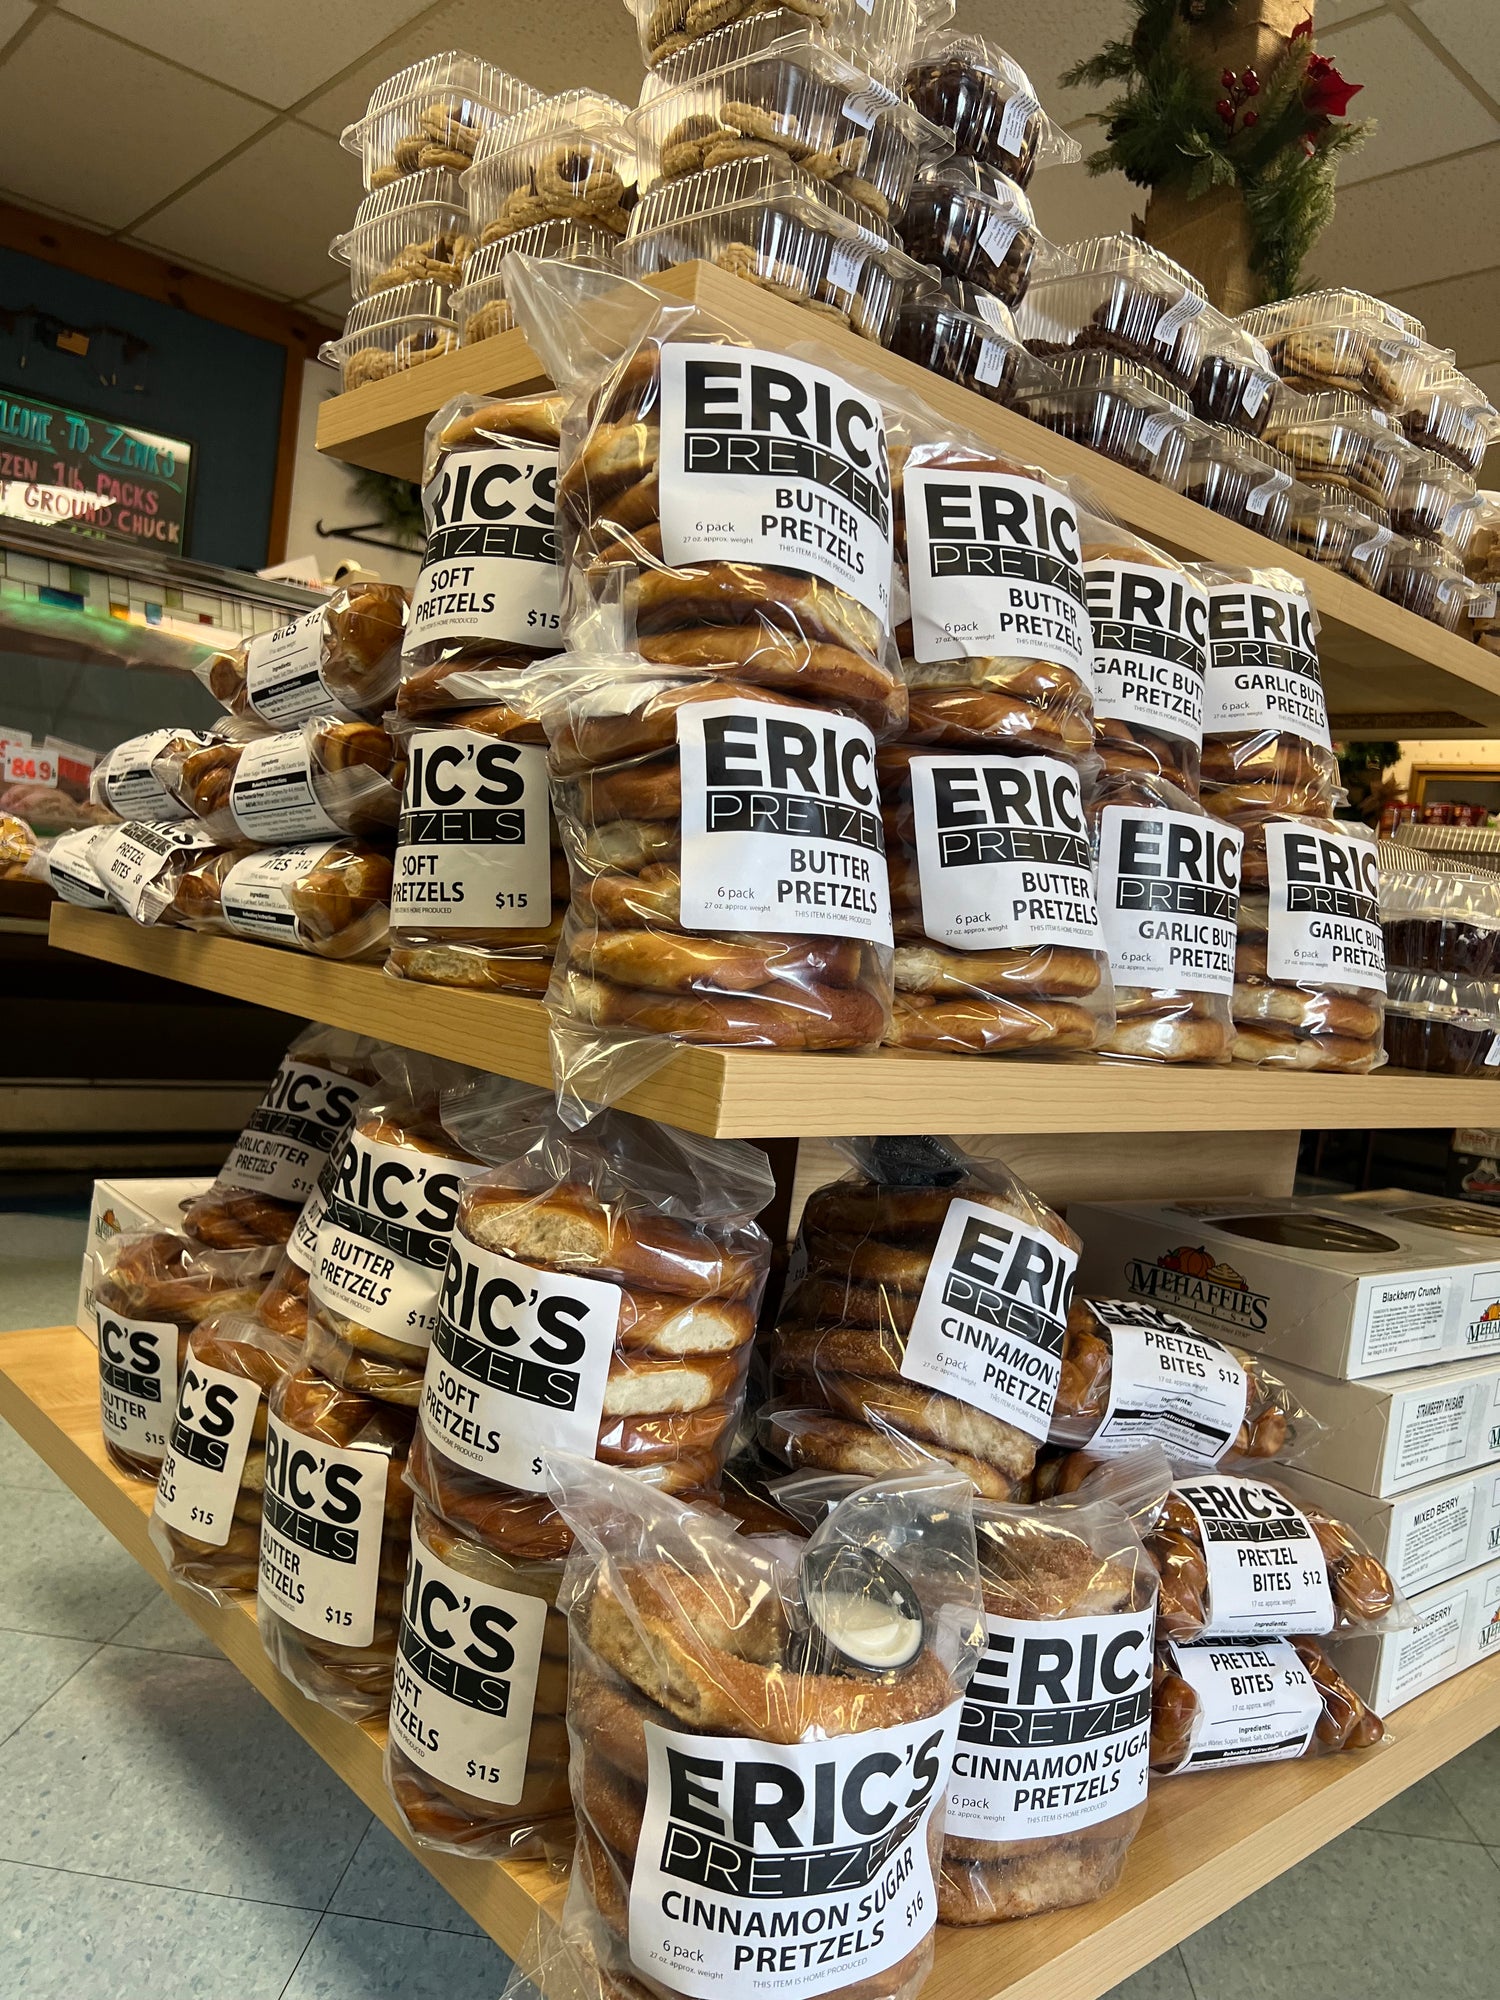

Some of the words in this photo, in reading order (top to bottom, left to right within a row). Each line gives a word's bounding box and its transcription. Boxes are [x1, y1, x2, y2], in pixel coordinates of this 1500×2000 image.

[685, 360, 890, 500] ERIC'S
[100, 426, 176, 479] ZINK'S
[97, 474, 159, 516] PACKS
[689, 436, 889, 538] PRETZELS
[25, 484, 112, 527] GROUND
[117, 510, 181, 544] CHUCK
[776, 488, 858, 542] BUTTER
[696, 522, 704, 533] 6
[707, 521, 735, 534] pack
[683, 535, 691, 544] 27
[730, 536, 754, 546] weight
[761, 515, 865, 576] PRETZELS
[779, 544, 796, 554] THIS
[796, 546, 811, 557] ITEM
[430, 567, 475, 592] SOFT
[416, 592, 496, 625] PRETZELS
[527, 609, 561, 630] $15
[1009, 587, 1078, 627] BUTTER
[945, 621, 952, 632] 6
[954, 621, 979, 634] pack
[1000, 612, 1083, 656] PRETZELS
[1093, 656, 1168, 686] GARLIC
[1235, 674, 1297, 696] GARLIC
[1221, 702, 1228, 711] 6
[1229, 701, 1250, 713] pack
[1266, 694, 1325, 728] PRETZELS
[116, 841, 146, 866] PRETZEL
[402, 854, 439, 876] SOFT
[790, 848, 870, 883] BUTTER
[111, 859, 131, 880] BITES
[717, 886, 726, 898] 6
[728, 887, 755, 900] pack
[777, 879, 878, 915] PRETZELS
[1022, 871, 1090, 899] BUTTER
[495, 891, 528, 910] $15
[749, 904, 771, 914] weight
[1012, 899, 1097, 926] PRETZELS
[795, 910, 809, 918] THIS
[810, 911, 824, 919] ITEM
[833, 912, 847, 921] HOME
[955, 913, 963, 925] 6
[965, 911, 992, 926] pack
[987, 924, 1009, 933] weight
[1139, 920, 1209, 945] GARLIC
[1309, 921, 1363, 944] GARLIC
[1121, 951, 1127, 961] 6
[1129, 952, 1152, 964] pack
[1293, 949, 1300, 959] 6
[1301, 950, 1319, 962] pack
[1332, 945, 1386, 974] PRETZELS
[235, 1153, 278, 1175] PRETZELS
[263, 1141, 310, 1167] BUTTER
[291, 1177, 314, 1194] $15
[331, 1236, 395, 1280] BUTTER
[320, 1258, 392, 1307] PRETZELS
[1382, 1289, 1417, 1303] Blackberry
[1418, 1285, 1441, 1298] Crunch
[1125, 1262, 1268, 1330] MEHAFFIES
[406, 1310, 436, 1330] $15
[941, 1316, 1057, 1387] CINNAMON
[1144, 1331, 1214, 1362] PRETZEL
[936, 1352, 944, 1363] 6
[945, 1355, 969, 1374] pack
[1159, 1354, 1206, 1378] BITES
[1218, 1368, 1240, 1385] $12
[438, 1370, 480, 1414] SOFT
[425, 1385, 501, 1455] PRETZELS
[145, 1431, 165, 1446] $15
[454, 1442, 484, 1463] PRODUCED
[1177, 1485, 1296, 1521] ERIC'S
[1413, 1507, 1436, 1527] MIXED
[1437, 1496, 1460, 1516] BERRY
[190, 1506, 215, 1526] $15
[1205, 1520, 1308, 1541] PRETZELS
[263, 1527, 300, 1576] BUTTER
[1237, 1546, 1298, 1568] PRETZEL
[1252, 1571, 1292, 1593] BITES
[1302, 1570, 1322, 1586] $12
[325, 1606, 353, 1627] $15
[1209, 1650, 1276, 1671] PRETZEL
[395, 1657, 423, 1709] SOFT
[1231, 1673, 1274, 1696] BITES
[1284, 1669, 1307, 1688] $12
[1238, 1723, 1272, 1735] Ingredients:
[466, 1760, 501, 1784] $15
[951, 1748, 1099, 1782] CINNAMON
[667, 1728, 944, 1849] ERIC'S
[1013, 1769, 1121, 1812] PRETZELS
[951, 1794, 960, 1805] 6
[962, 1796, 990, 1810] pack
[984, 1813, 1006, 1823] weight
[1027, 1816, 1040, 1825] THIS
[1040, 1815, 1056, 1824] ITEM
[1062, 1810, 1080, 1820] HOME
[664, 1803, 924, 1895] PRETZELS
[661, 1890, 849, 1938] CINNAMON
[857, 1847, 914, 1922] SUGAR
[906, 1890, 924, 1927] $16
[663, 1940, 672, 1952] 6
[674, 1944, 705, 1963] pack
[734, 1919, 885, 1972] PRETZELS
[650, 1951, 658, 1960] 27
[670, 1959, 697, 1974] approx.
[697, 1968, 724, 1981] weight
[753, 1980, 770, 1988] THIS
[771, 1978, 793, 1988] ITEM
[794, 1976, 802, 1986] IS
[803, 1970, 827, 1985] HOME
[827, 1957, 868, 1977] PRODUCED
